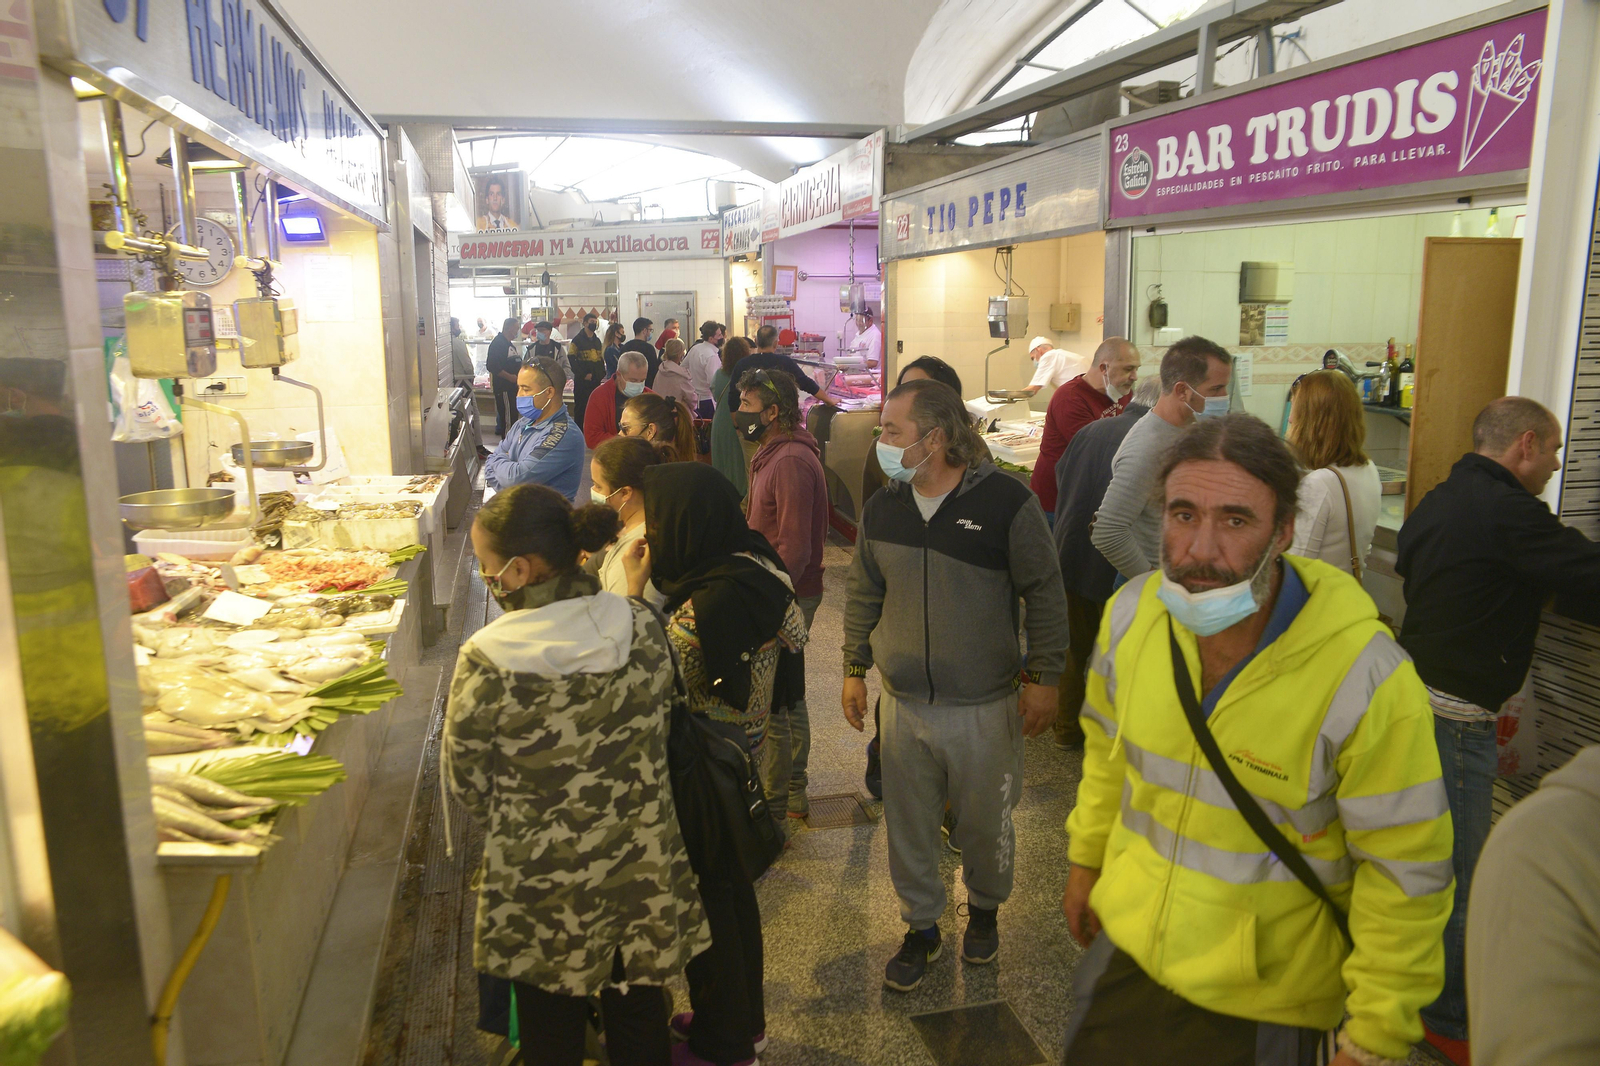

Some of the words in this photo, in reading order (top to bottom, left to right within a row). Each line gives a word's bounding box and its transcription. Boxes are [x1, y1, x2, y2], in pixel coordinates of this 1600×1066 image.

[1115, 133, 1129, 153] 23
[1156, 123, 1235, 180] BAR
[1245, 70, 1459, 165] TRUDIS
[1123, 161, 1149, 176] Estrella
[1124, 173, 1147, 189] Galicia
[1156, 179, 1225, 197] ESPECIALIDADES
[1230, 176, 1243, 187] EN
[1306, 160, 1344, 175] FRITO.
[1353, 152, 1387, 168] PARA
[1391, 143, 1451, 163] LLEVAR.
[781, 163, 840, 229] CARNICERIA
[927, 202, 956, 235] TIO
[968, 182, 1027, 228] PEPE
[460, 239, 544, 260] CARNICERIA
[579, 233, 690, 255] Auxiliadora
[702, 240, 716, 248] 18
[995, 804, 1011, 874] adidas
